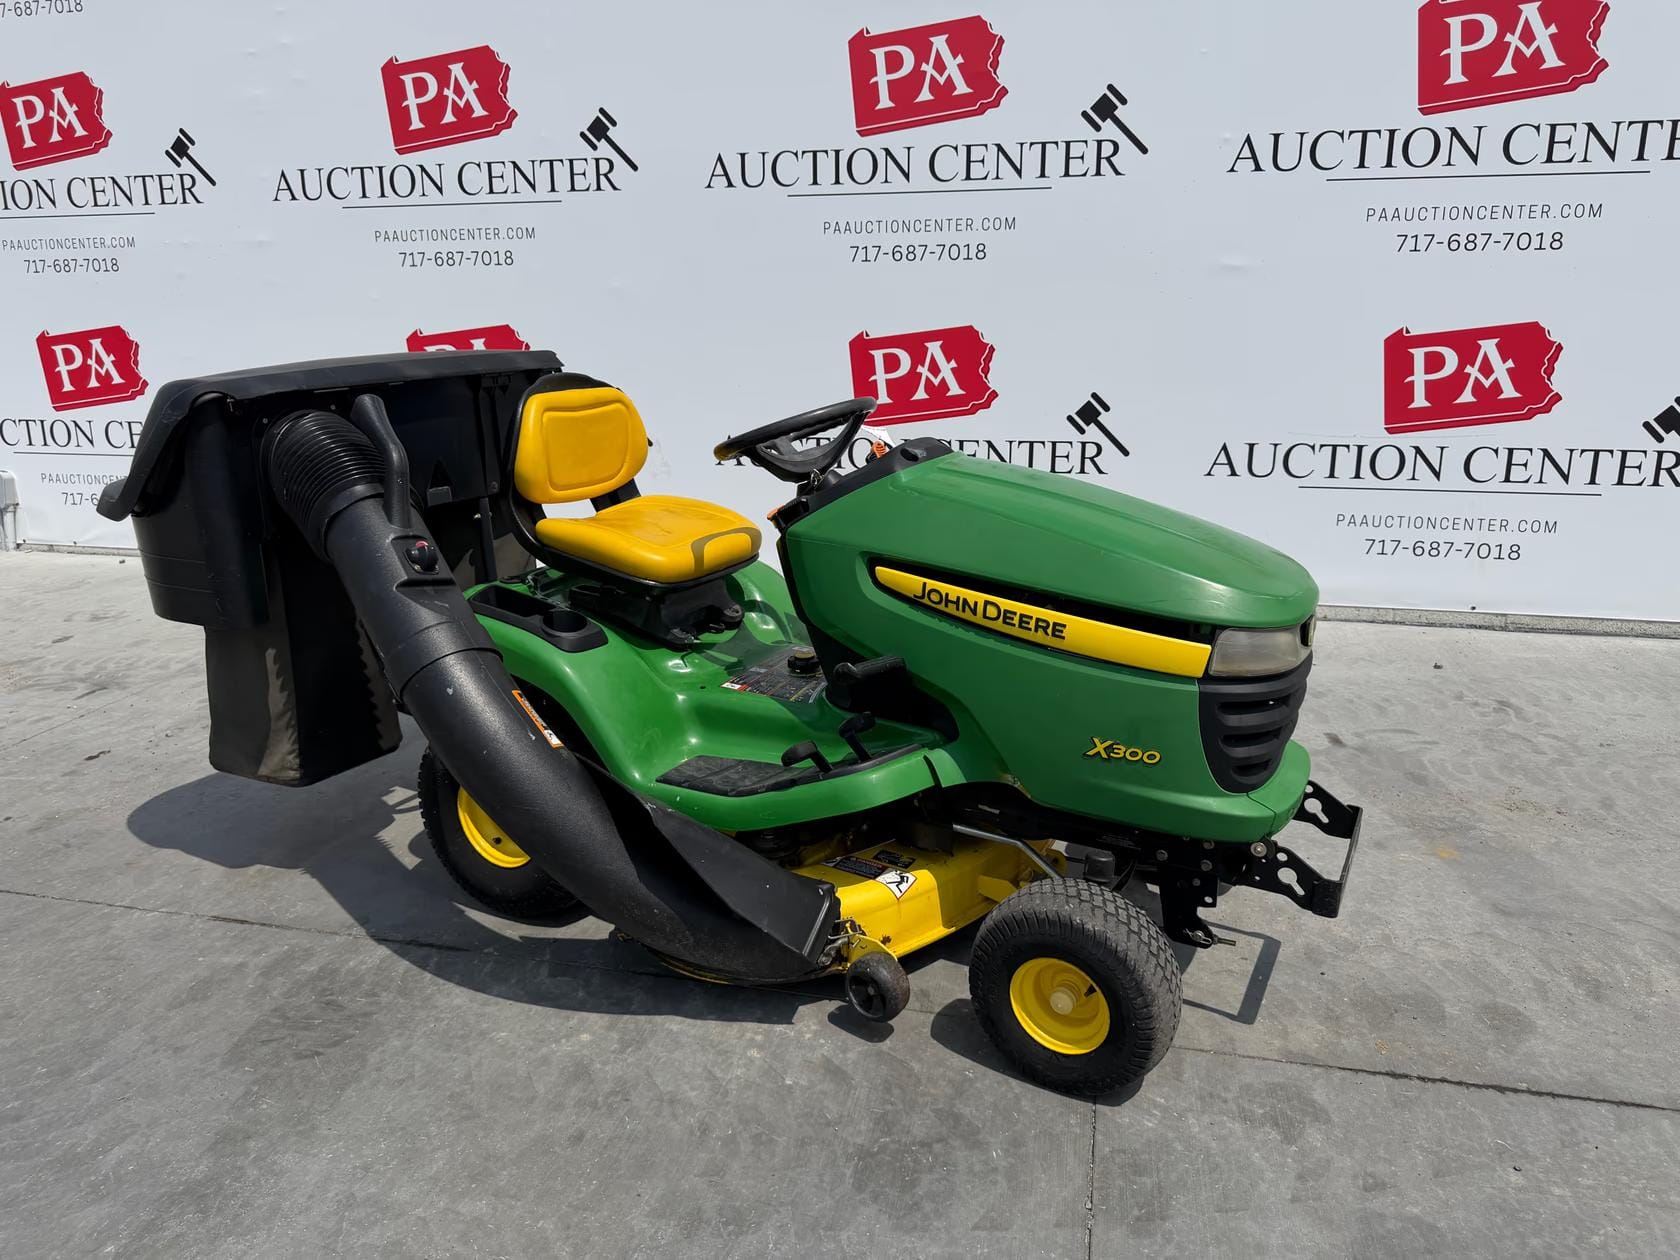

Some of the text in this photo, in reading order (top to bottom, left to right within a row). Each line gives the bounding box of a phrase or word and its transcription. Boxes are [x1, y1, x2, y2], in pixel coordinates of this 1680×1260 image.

[1440, 1, 1566, 86] PA
[869, 34, 974, 110] PA
[399, 62, 489, 131] PA
[12, 87, 88, 149] PA
[704, 139, 1126, 189] AUCTION CENTER
[1226, 126, 1488, 173] AUCTION
[67, 173, 204, 208] CENTER
[272, 157, 622, 201] AUCTION CENTER
[824, 217, 1015, 235] PAAUCTIONCENTER.COM
[1366, 203, 1602, 222] PAAUCTIONCENTER.COM
[2, 237, 135, 250] PAAUCTIONCENTER.COM
[374, 227, 535, 242] PAAUCTIONCENTER.COM
[1397, 232, 1563, 252] 717-687-7018
[24, 258, 119, 273] 717-687-7018
[398, 250, 514, 267] 717-687-7018
[850, 243, 986, 262] 717-687-7018
[51, 338, 125, 392] PA
[868, 340, 966, 404] PA
[1405, 339, 1521, 408] PA
[939, 439, 1108, 474] ENTER
[1203, 442, 1680, 487] AUCTION CENTER
[1336, 514, 1557, 534] PAAUCTIONCENTER.COM
[1365, 539, 1520, 560] 717-687-7018
[913, 582, 1067, 640] JOHN DEERE
[1084, 737, 1161, 764] X300
